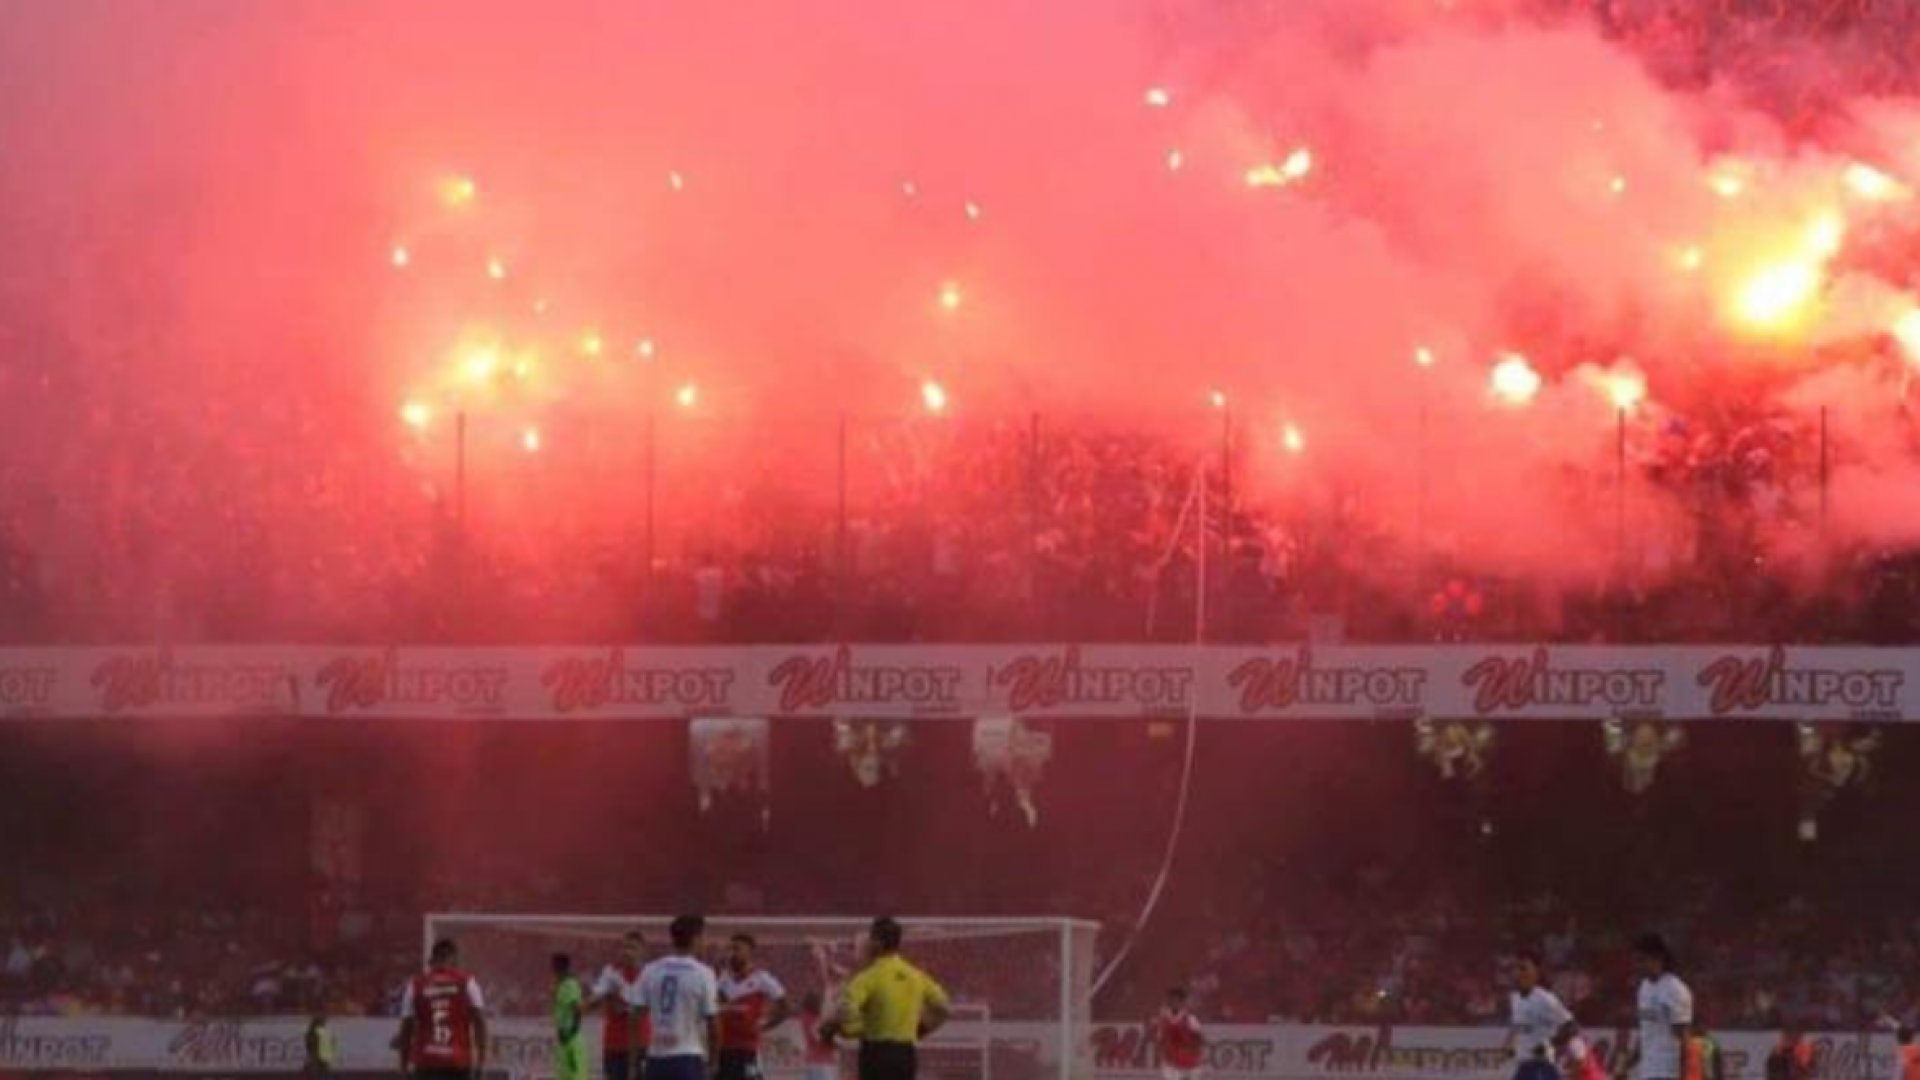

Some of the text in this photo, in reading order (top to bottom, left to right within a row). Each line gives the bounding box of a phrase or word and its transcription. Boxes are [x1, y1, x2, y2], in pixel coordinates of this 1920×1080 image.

[315, 643, 508, 711] WINPOT
[540, 643, 733, 712] WINPOT
[768, 643, 960, 711] WINPOT
[997, 643, 1192, 711] WINPOT
[1226, 644, 1427, 712] WINPOT
[1461, 644, 1665, 713] WINPOT
[1697, 642, 1904, 713] WINPOT
